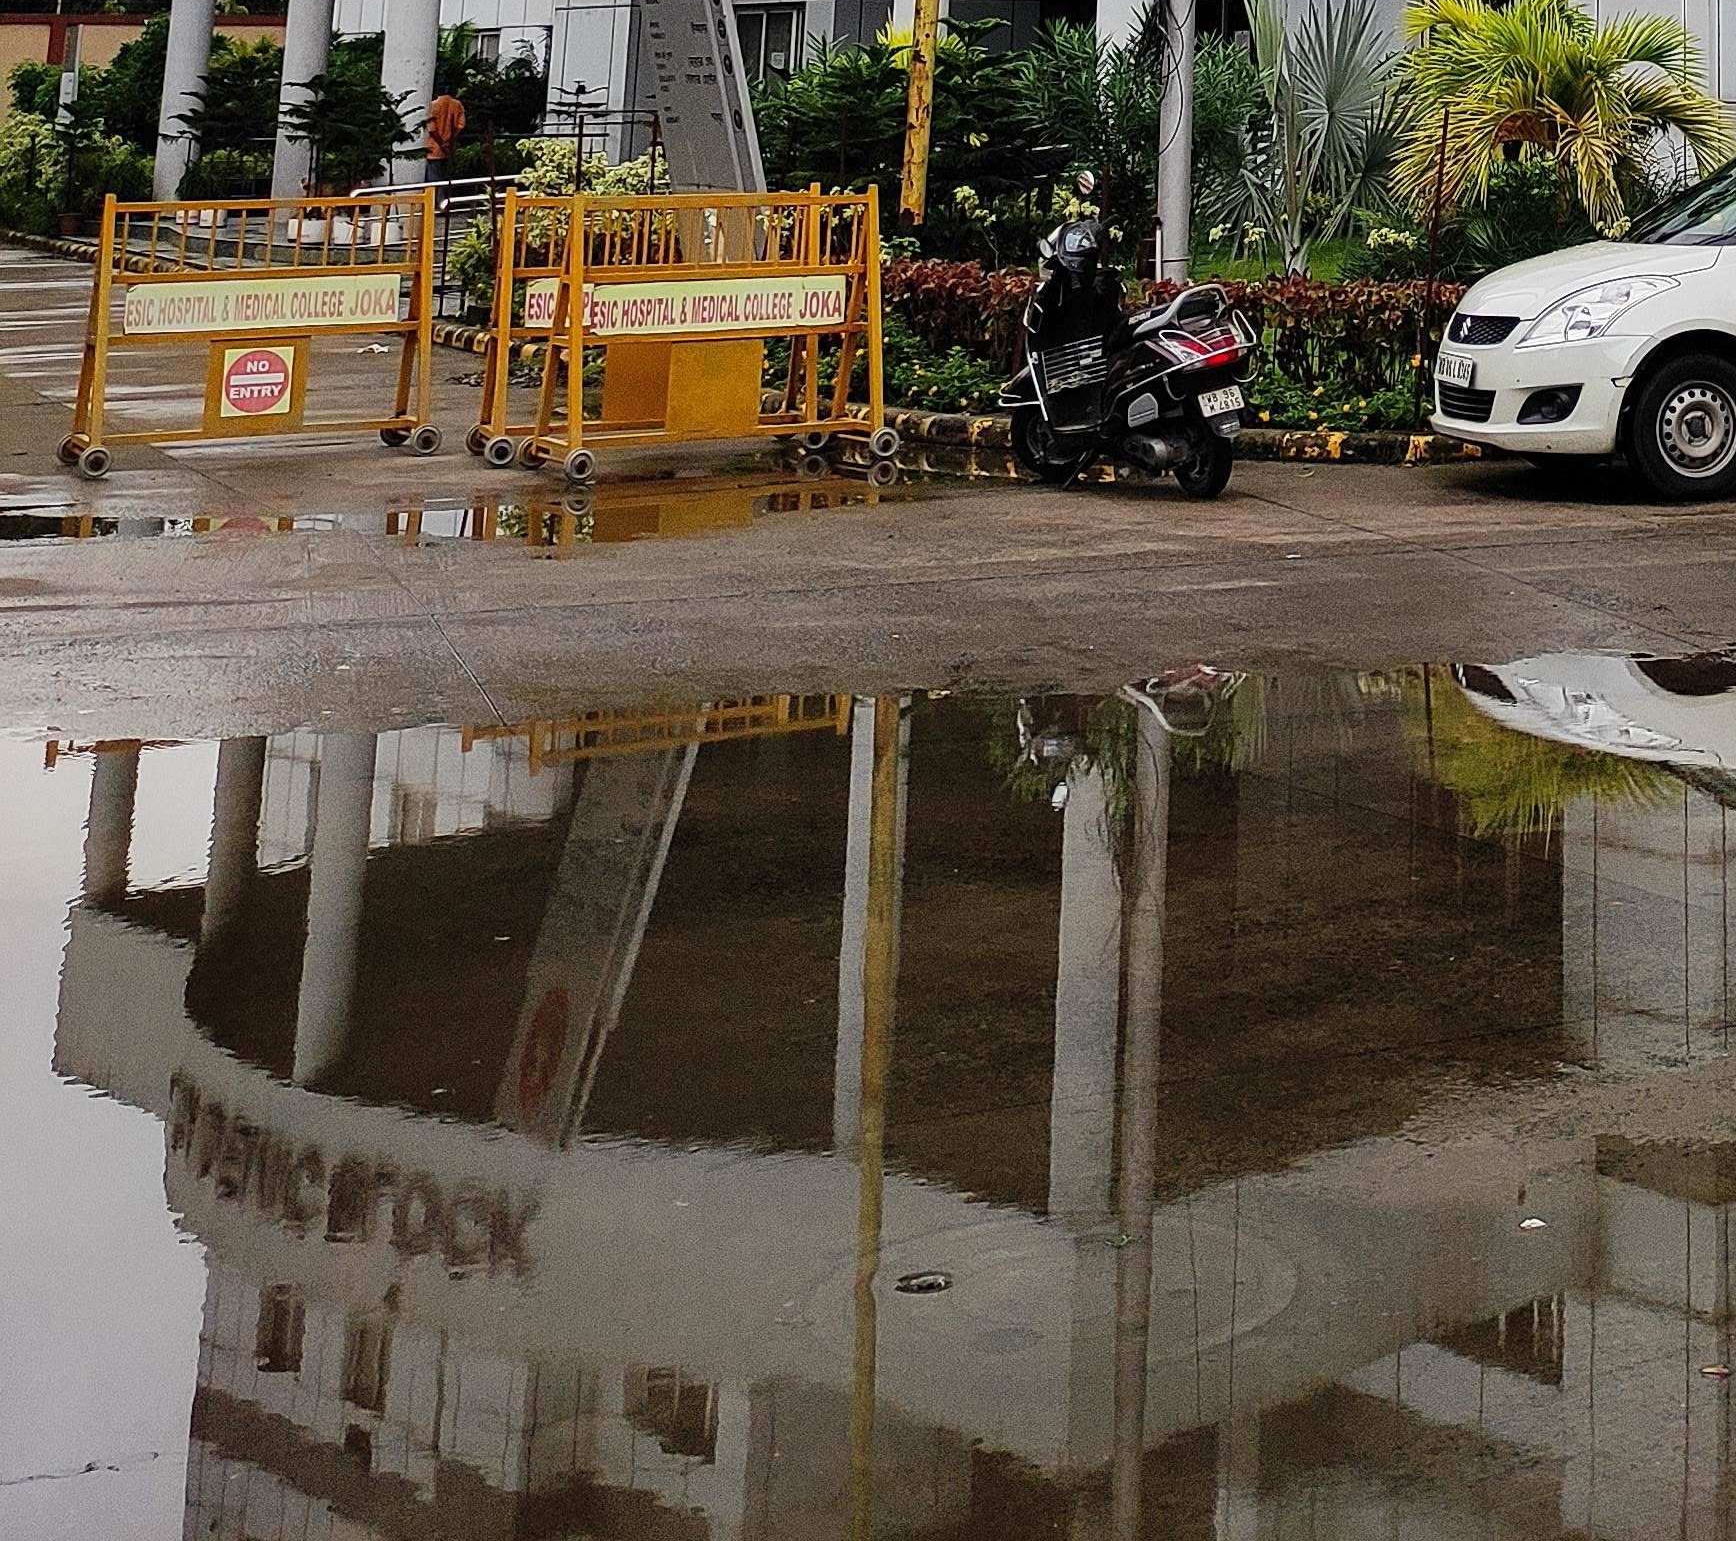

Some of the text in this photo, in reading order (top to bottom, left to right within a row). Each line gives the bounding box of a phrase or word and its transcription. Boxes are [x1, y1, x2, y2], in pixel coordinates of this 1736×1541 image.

[126, 288, 396, 327] ESIC HOSPITAL & MEDICAL COLLEGE JOKA
[528, 292, 555, 320] ESIC
[591, 300, 619, 329] ESIC
[621, 297, 676, 328] HOSPITAL
[679, 296, 688, 325] &
[691, 294, 740, 324] MEDICAL
[744, 292, 793, 321] COLLEGE
[799, 290, 843, 319] JOKA
[246, 360, 270, 373] NO
[229, 384, 283, 399] ENTRY
[1222, 388, 1235, 399] 96
